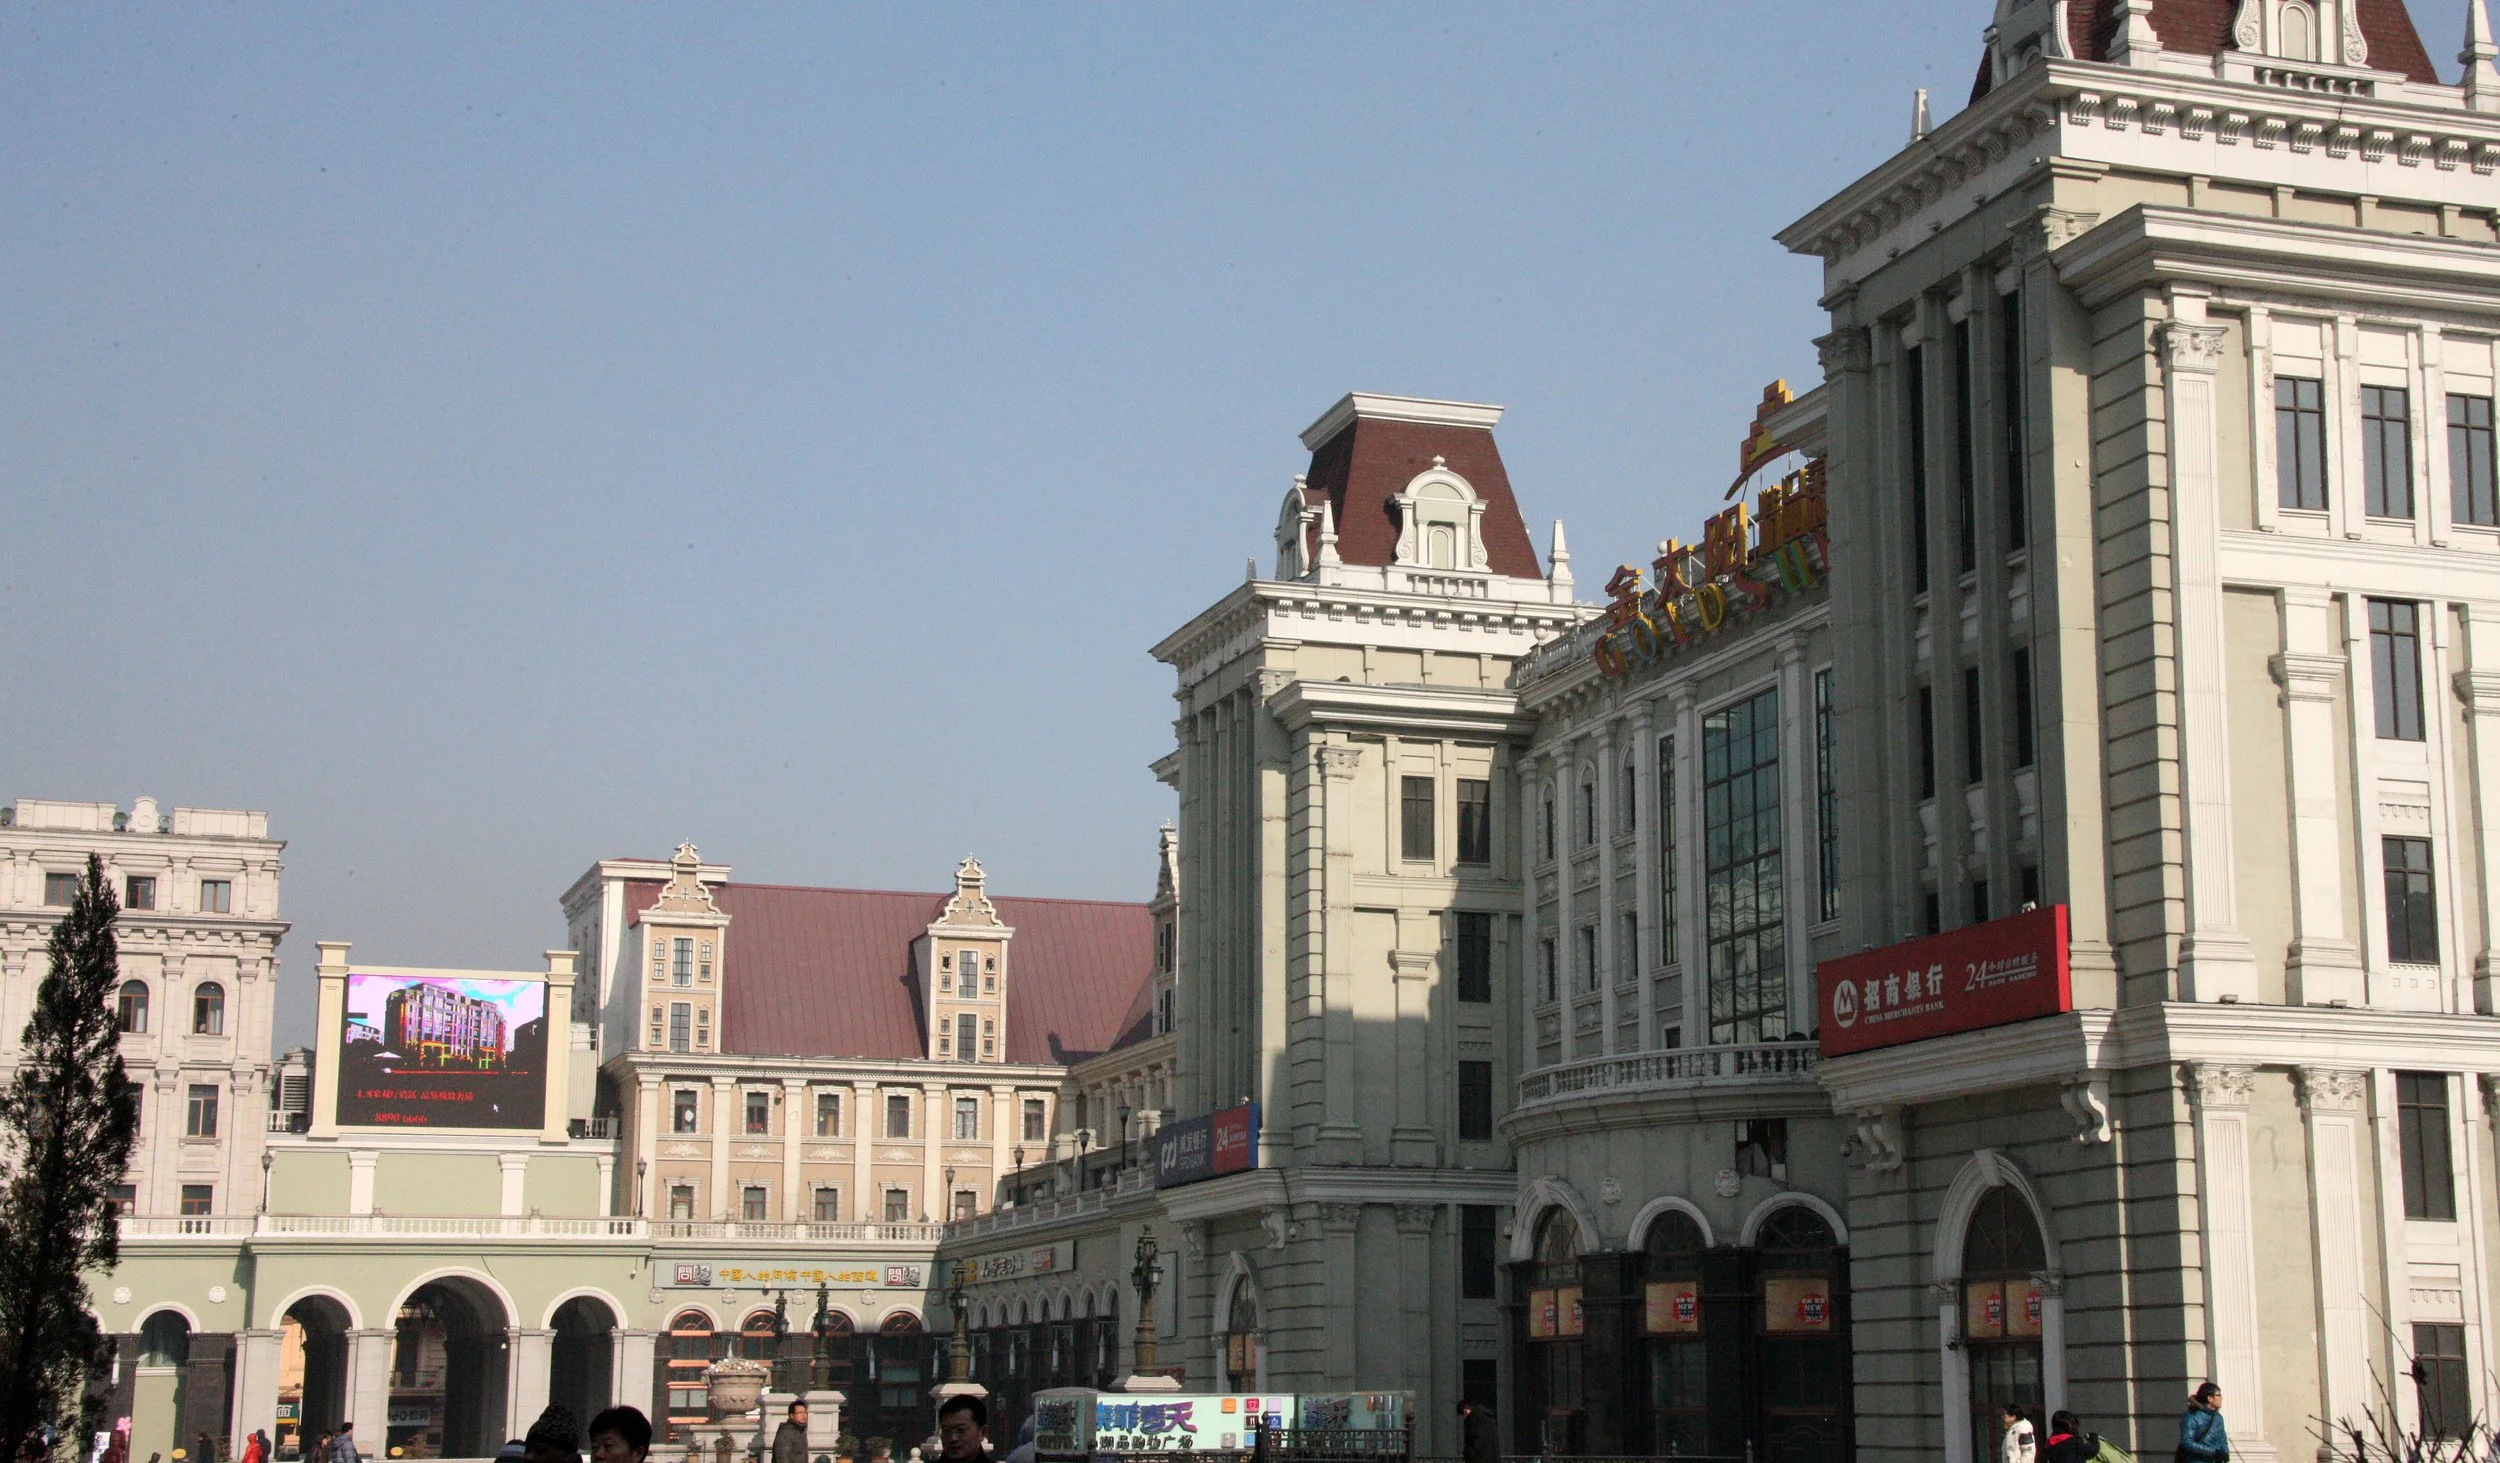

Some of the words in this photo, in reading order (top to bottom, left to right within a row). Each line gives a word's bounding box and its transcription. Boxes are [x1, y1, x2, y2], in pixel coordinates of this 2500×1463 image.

[1864, 964, 1944, 1011] 招商银行
[1964, 960, 1986, 992] 24
[1884, 1005, 1924, 1020] MERCHANTS
[1925, 1001, 1944, 1014] BANK
[1216, 1125, 1228, 1152] 24
